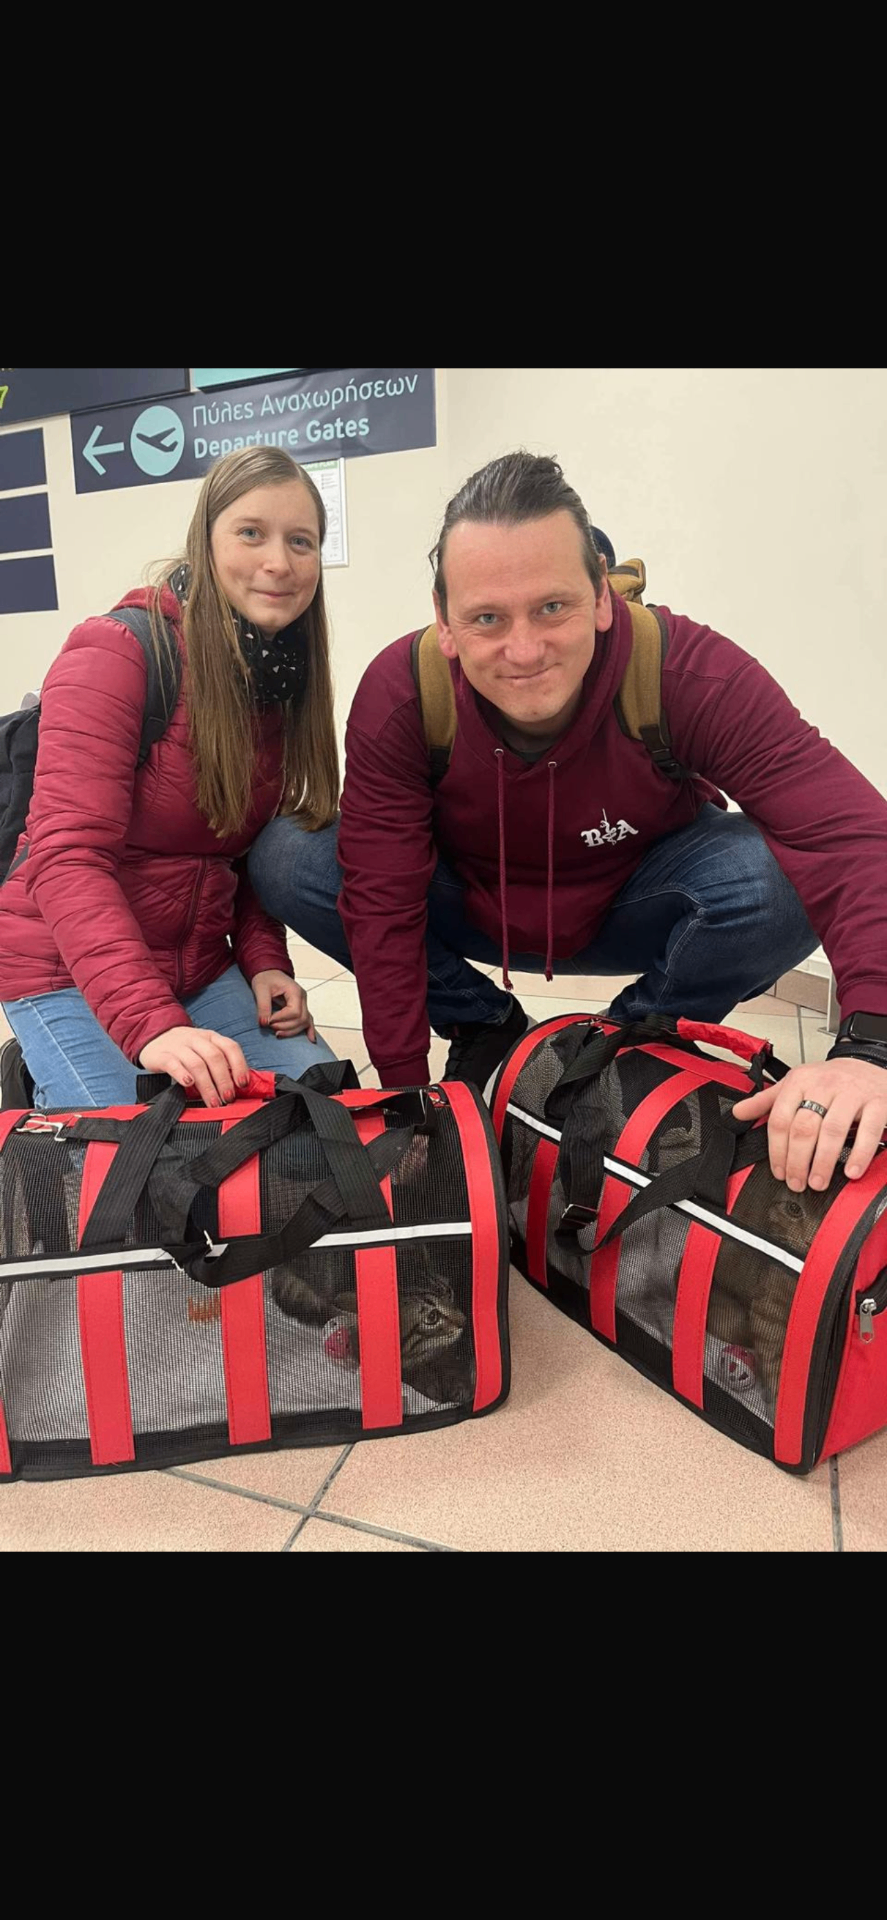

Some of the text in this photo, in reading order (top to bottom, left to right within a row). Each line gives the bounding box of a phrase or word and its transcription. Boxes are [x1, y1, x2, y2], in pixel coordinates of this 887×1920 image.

[193, 374, 418, 428] Πύλες Αναχωρήσεων
[306, 417, 370, 443] Gates
